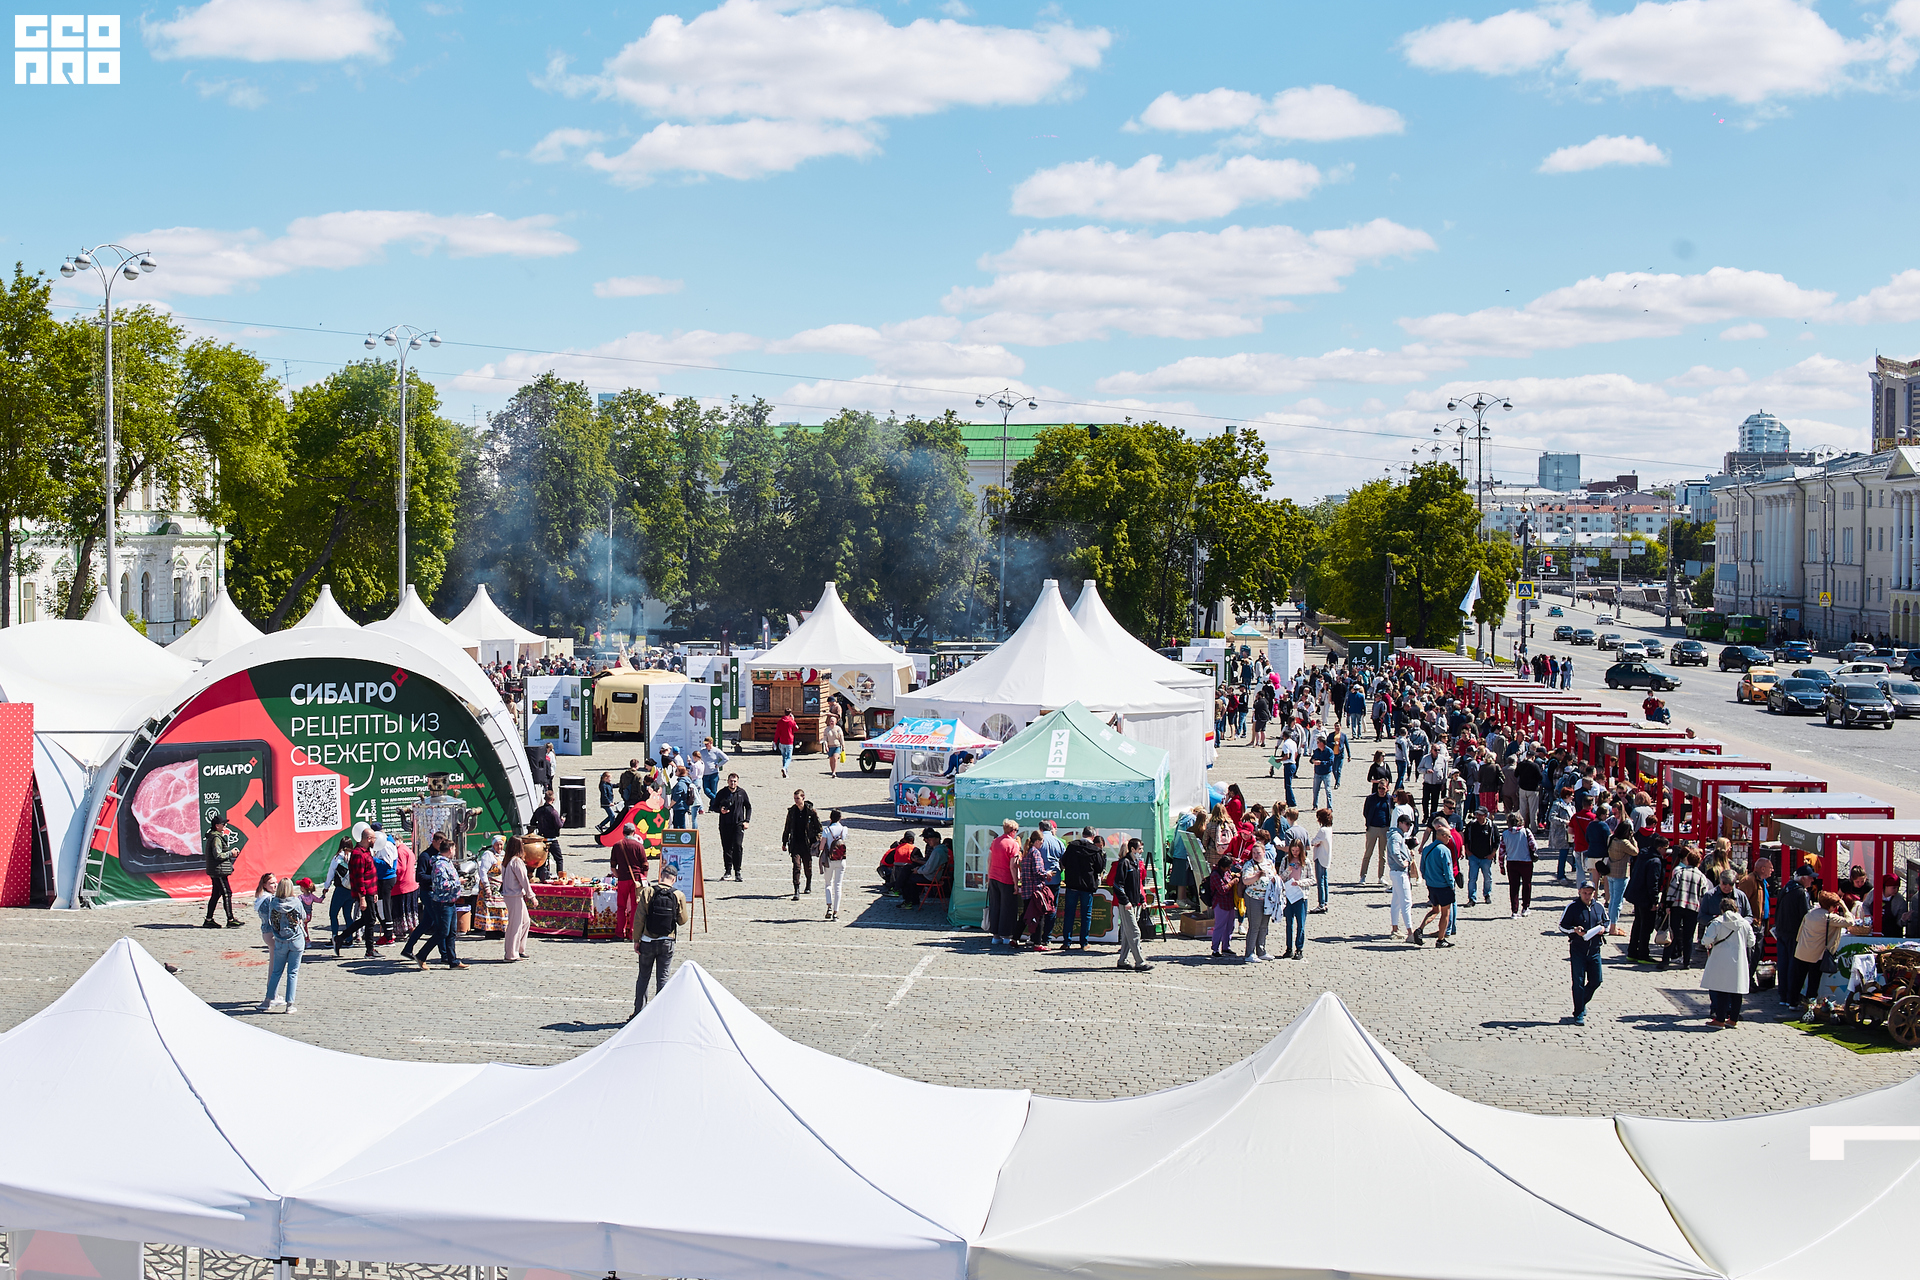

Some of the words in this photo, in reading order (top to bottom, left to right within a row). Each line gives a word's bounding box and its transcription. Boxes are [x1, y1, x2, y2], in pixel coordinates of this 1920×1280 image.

[756, 670, 803, 681] ITALY
[290, 681, 397, 706] СИБАГРО
[291, 713, 403, 740] РЕЦЕПТЫ
[411, 712, 440, 733] ИЗ
[290, 741, 401, 766] СВЕЖЕГО
[408, 738, 473, 761] МЯСА
[1051, 731, 1066, 763] УРАЛ
[202, 763, 253, 776] СИБАГРО
[203, 792, 220, 800] 100%
[355, 799, 372, 822] 4
[1015, 809, 1090, 821] gotoural.com
